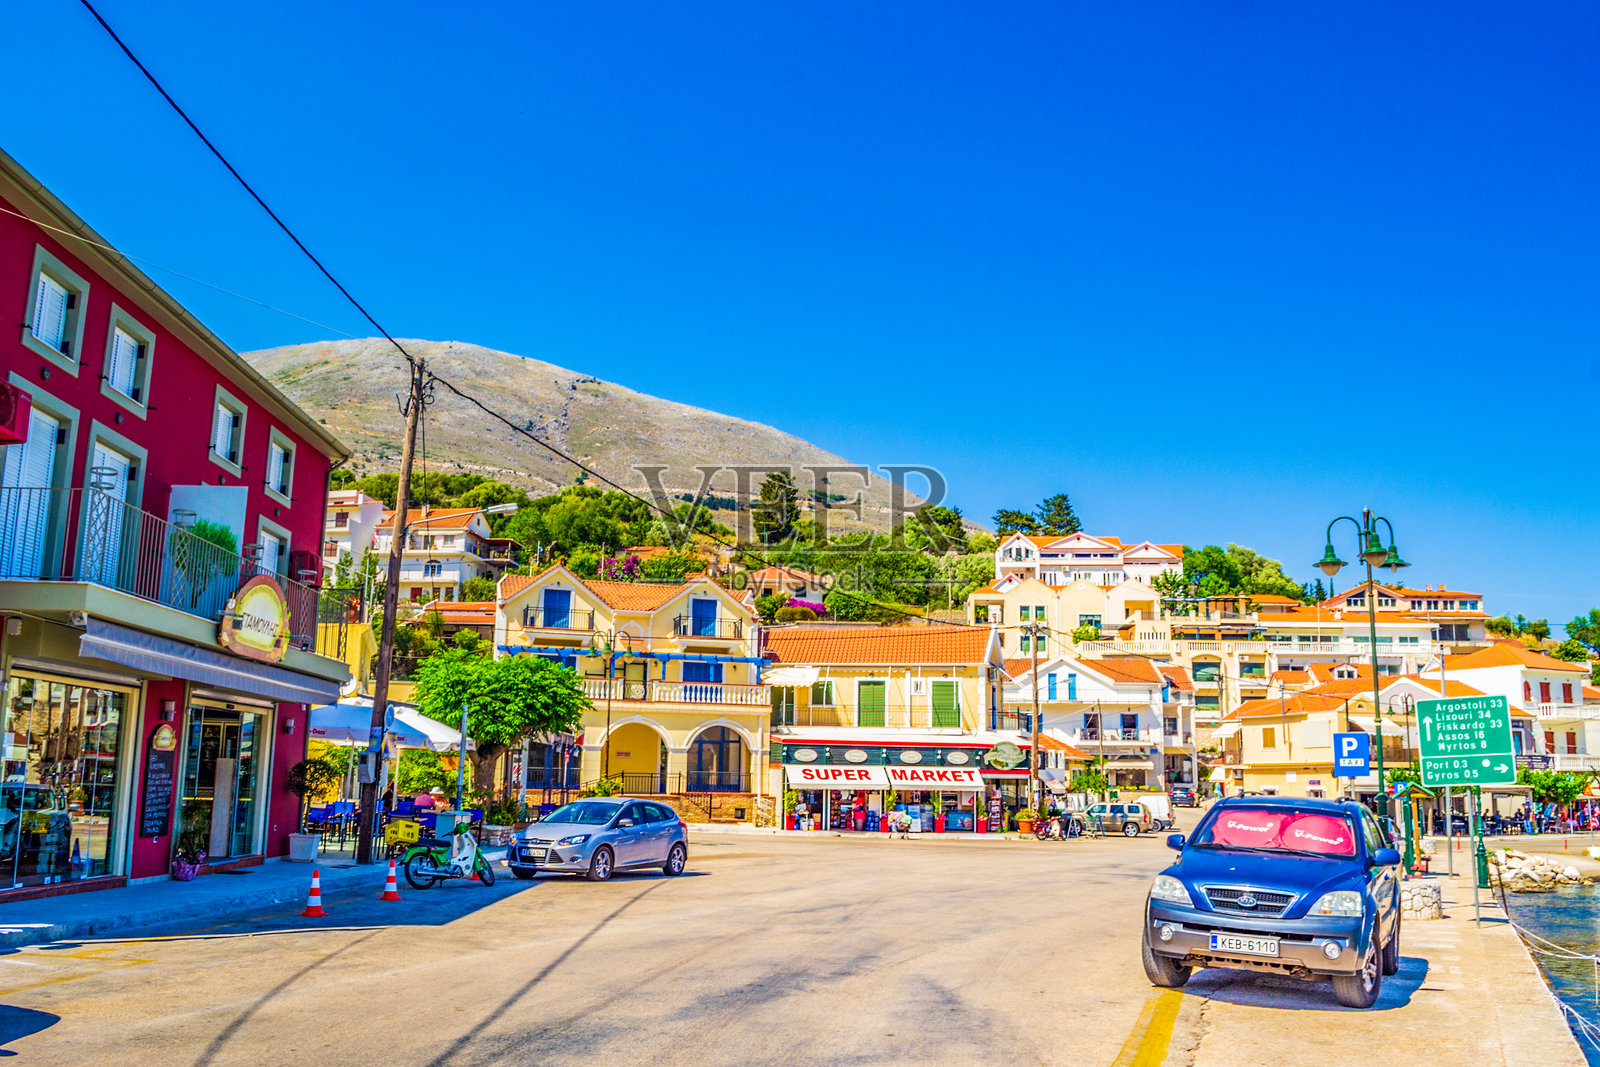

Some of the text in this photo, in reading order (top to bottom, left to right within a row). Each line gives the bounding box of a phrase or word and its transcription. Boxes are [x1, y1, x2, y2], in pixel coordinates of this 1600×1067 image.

[1436, 699, 1503, 712] Argostoli 33
[1435, 710, 1491, 721] Lixouri 34
[1436, 719, 1503, 731] Fiskardo 33
[1437, 730, 1485, 741] Assos 16
[1342, 737, 1358, 757] P
[1438, 740, 1487, 752] Myrtos 8
[1426, 761, 1449, 769] Port
[801, 768, 975, 782] SUPER MARKET
[1427, 771, 1460, 781] Gyros
[1221, 937, 1276, 953] KEB-6110
